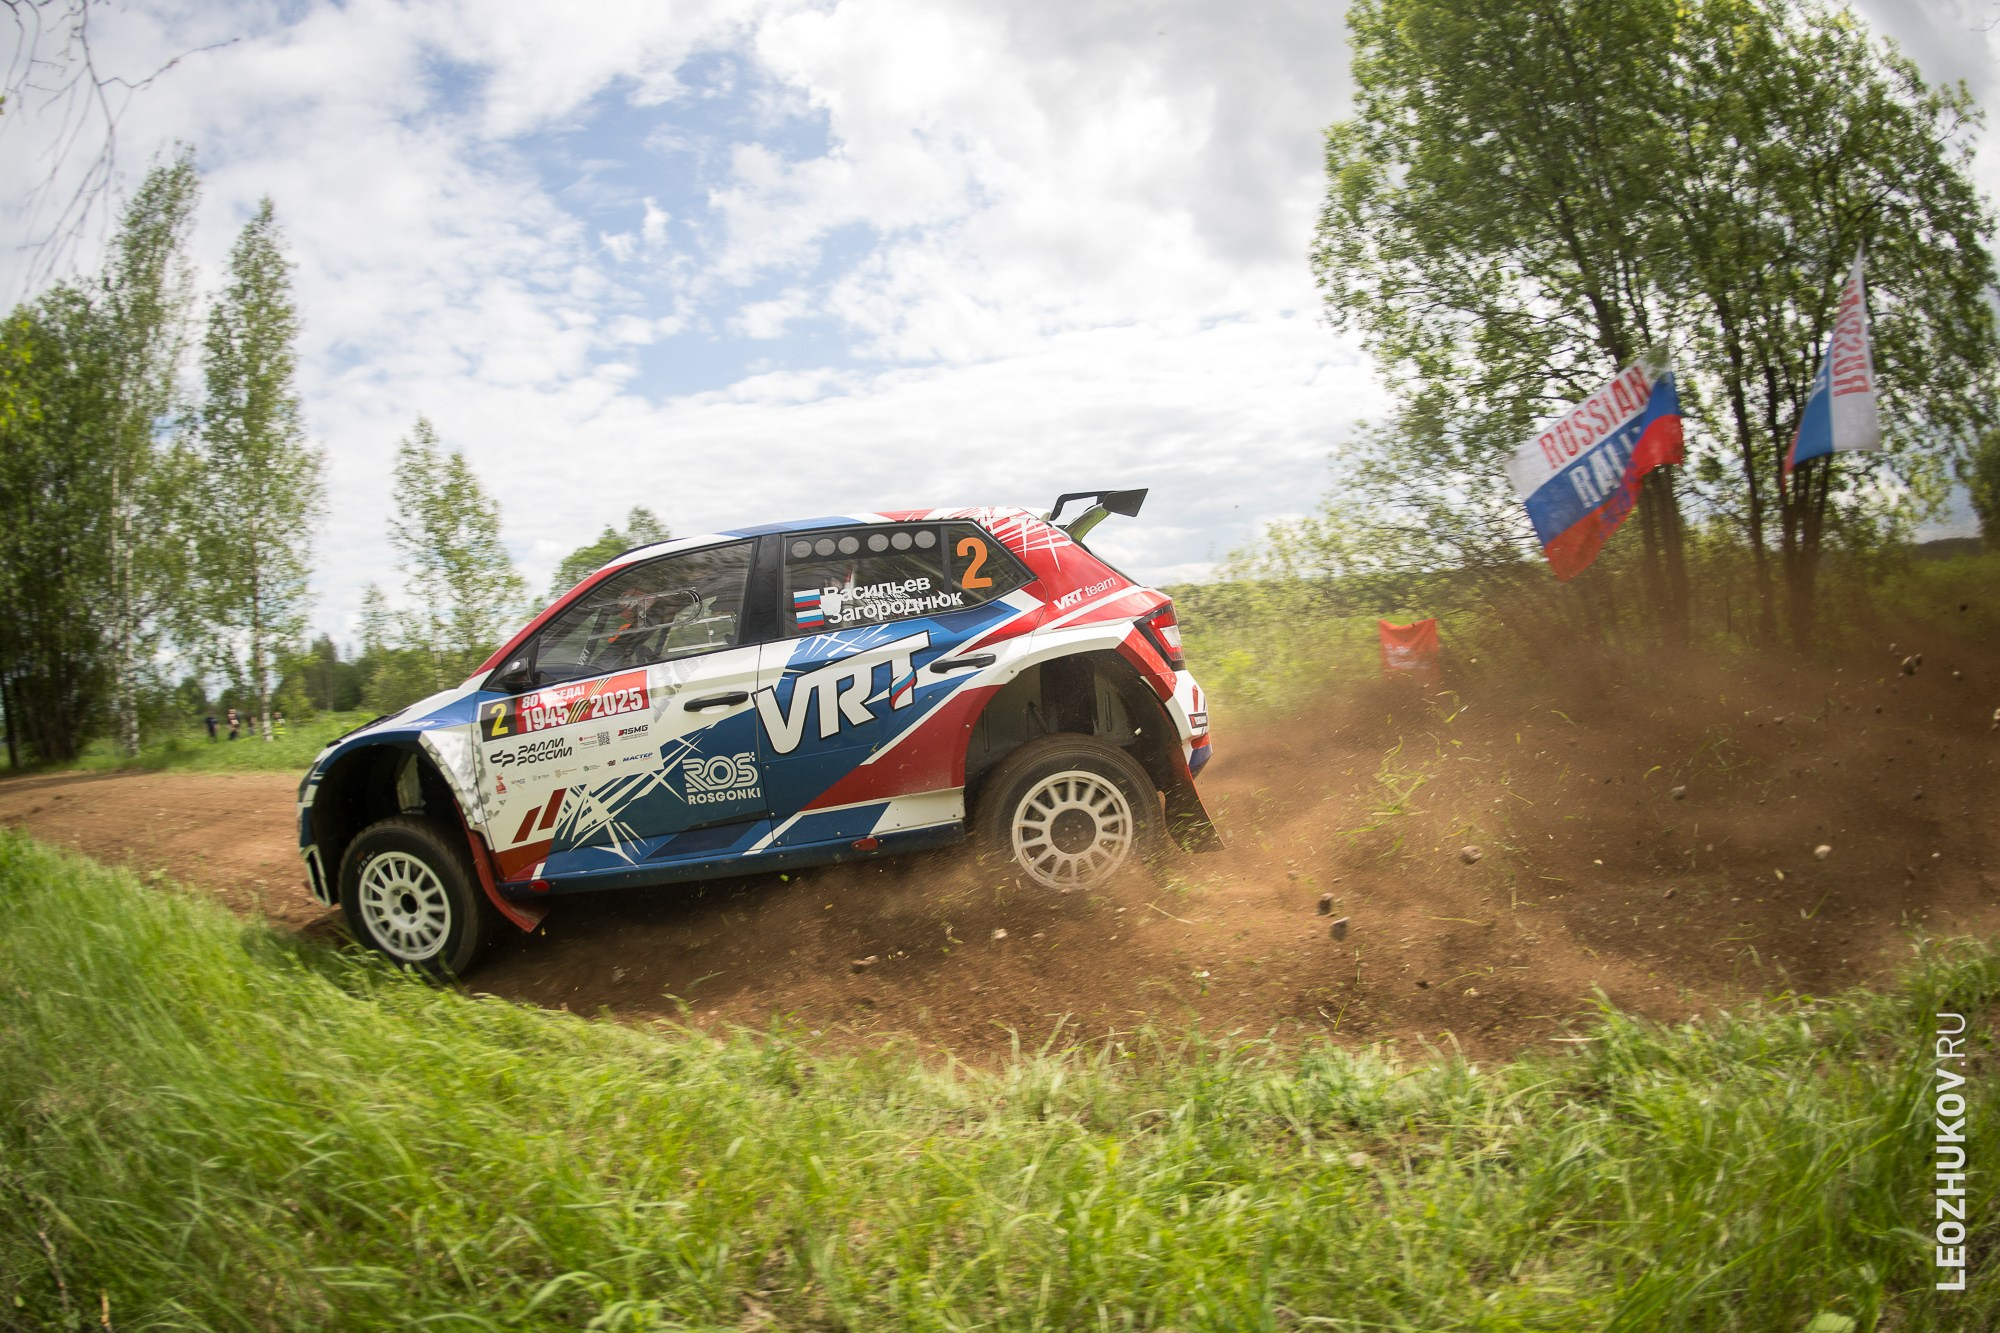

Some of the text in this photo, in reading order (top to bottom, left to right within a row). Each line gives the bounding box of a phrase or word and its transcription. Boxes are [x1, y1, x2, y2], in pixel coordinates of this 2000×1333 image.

[1538, 365, 1651, 470] RUSSIAN
[956, 537, 993, 589] 2
[823, 577, 931, 603] Васильев
[1053, 576, 1117, 611] VRT team
[828, 591, 965, 624] Загороднюк
[521, 694, 539, 709] 80
[591, 687, 644, 719] 2025
[751, 630, 932, 755] VRT
[490, 703, 509, 737] 2
[521, 701, 571, 732] 1945
[516, 746, 573, 767] РОССИИ
[518, 737, 565, 756] РАЛЛИ
[682, 751, 759, 794] ROS
[688, 787, 761, 806] ROSGONKI
